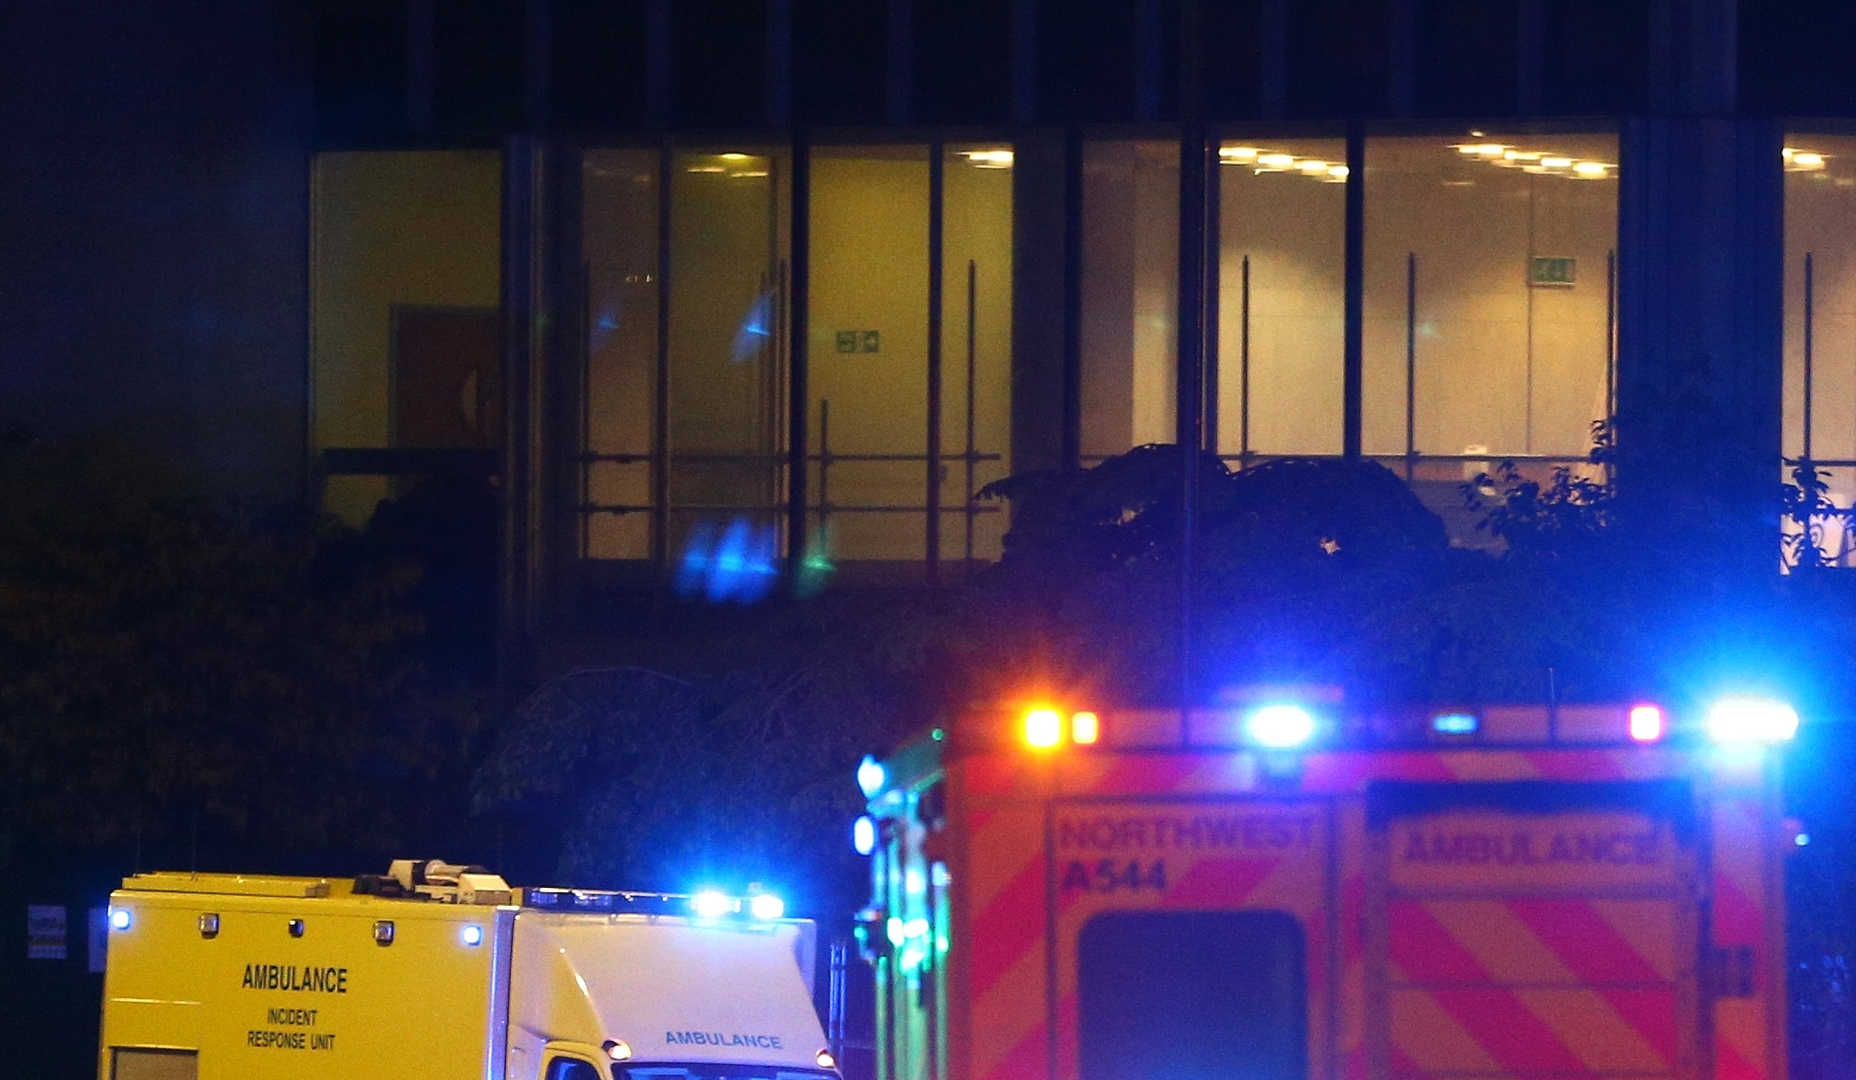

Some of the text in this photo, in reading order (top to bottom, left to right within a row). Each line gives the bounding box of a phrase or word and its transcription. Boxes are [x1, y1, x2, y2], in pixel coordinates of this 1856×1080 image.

[1060, 817, 1312, 849] NORTHWEST
[1405, 833, 1657, 866] AMBULANCE
[1063, 858, 1167, 891] A544
[242, 964, 347, 993] AMBULANCE
[267, 1008, 318, 1026] INCIDENT
[247, 1031, 336, 1050] RESPONSE UNIT
[665, 1031, 784, 1050] AMBULANCE
